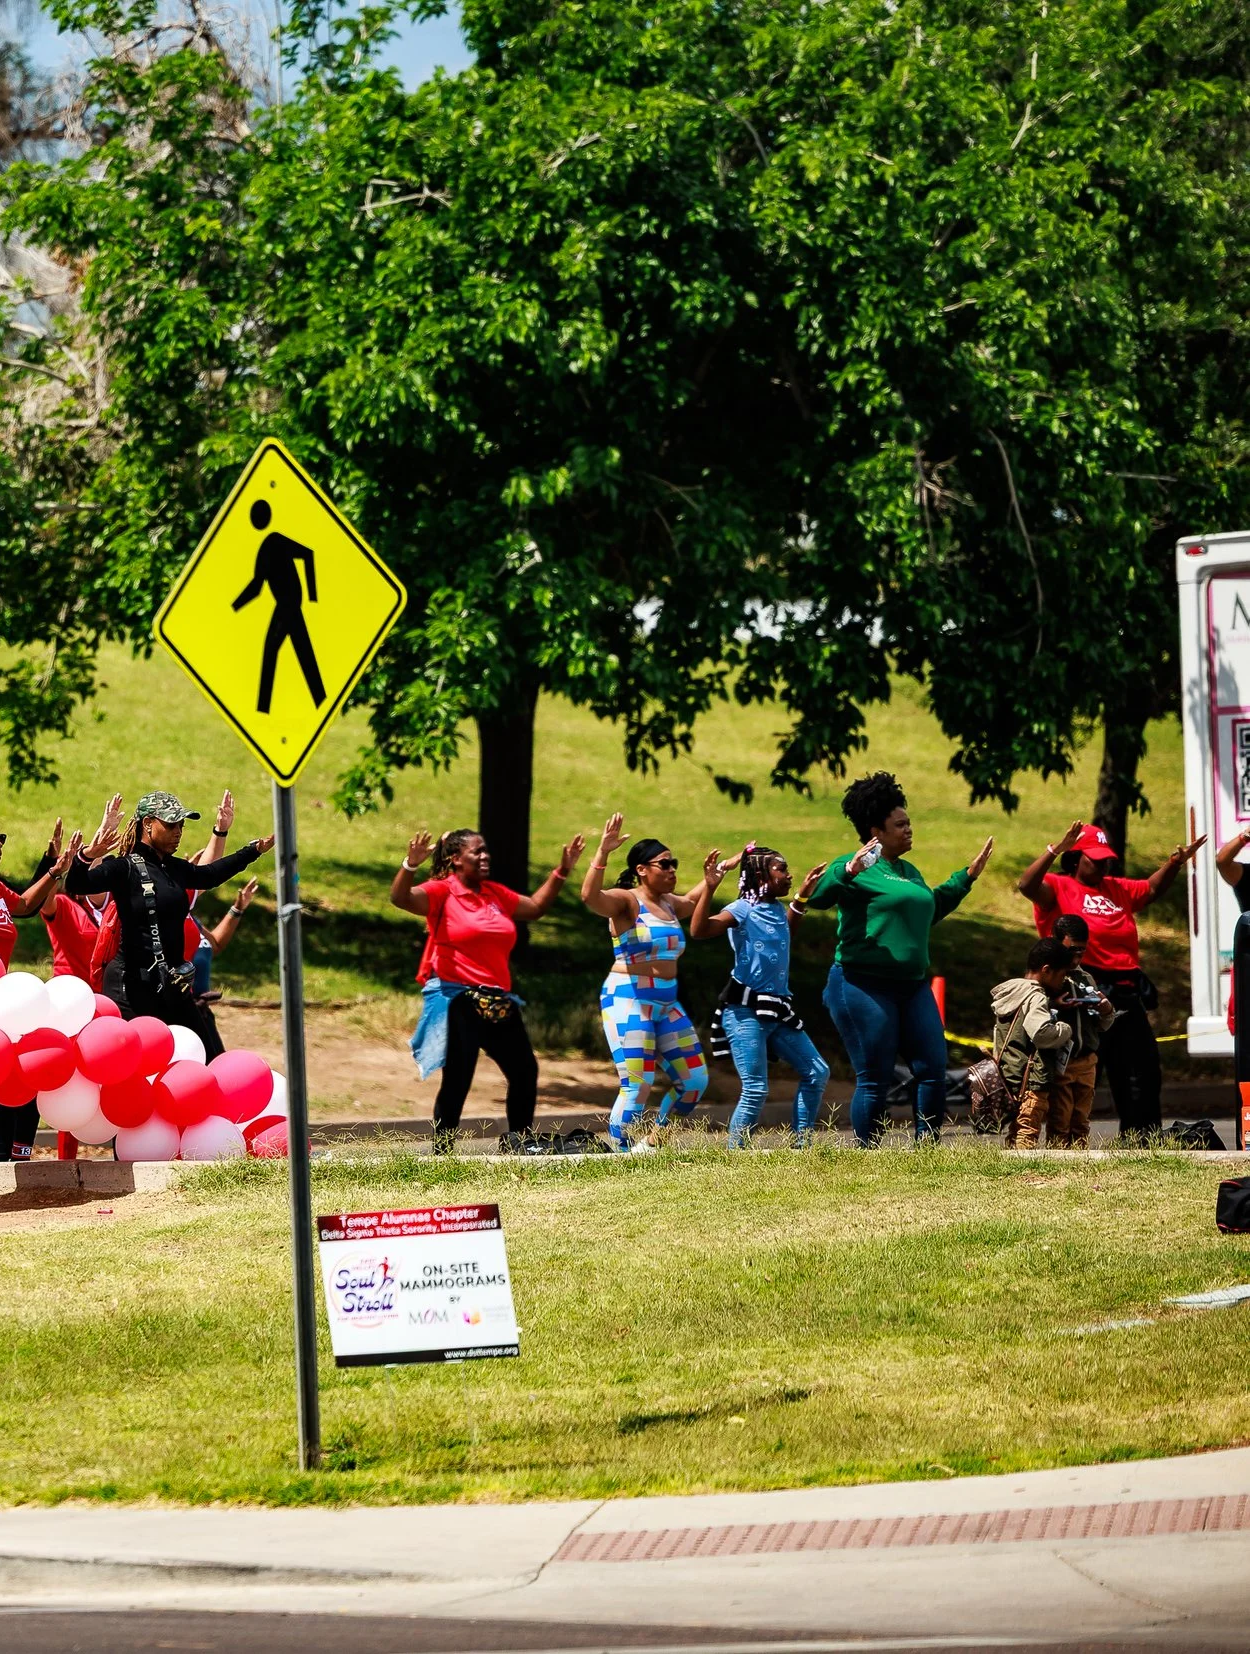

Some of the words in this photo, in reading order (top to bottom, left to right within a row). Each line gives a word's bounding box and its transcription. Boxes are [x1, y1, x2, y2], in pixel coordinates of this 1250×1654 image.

[150, 923, 162, 946] TOTE
[20, 1147, 31, 1155] 13
[338, 1214, 379, 1229] Tempe
[381, 1212, 431, 1225] Alumnae
[432, 1207, 480, 1222] Chapter
[321, 1228, 346, 1241] Delta
[345, 1227, 375, 1240] Sigma
[375, 1225, 401, 1236] Theta
[440, 1217, 499, 1232] Incorporated
[422, 1261, 480, 1277] ON-SITE
[335, 1269, 376, 1290] Soul
[400, 1273, 507, 1292] MAMMOGRAMS
[342, 1292, 394, 1313] Stroll
[449, 1295, 461, 1304] BY
[408, 1308, 450, 1325] MOM
